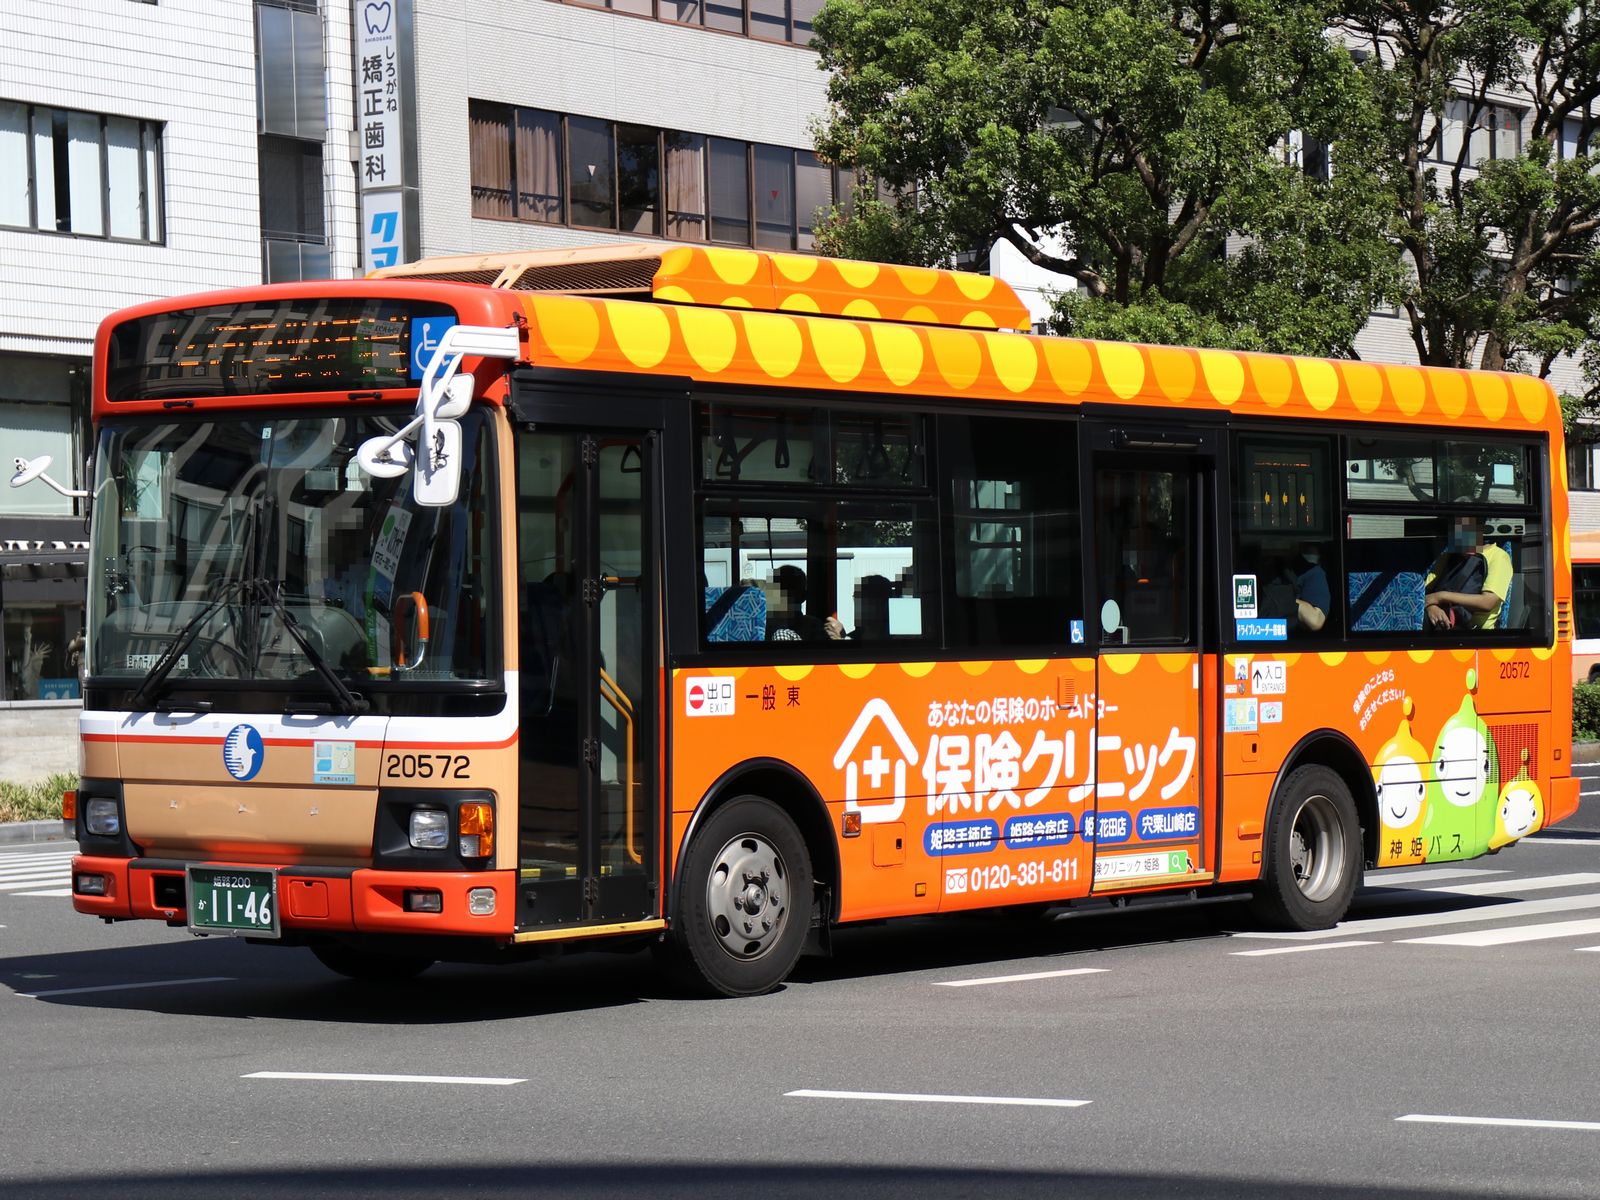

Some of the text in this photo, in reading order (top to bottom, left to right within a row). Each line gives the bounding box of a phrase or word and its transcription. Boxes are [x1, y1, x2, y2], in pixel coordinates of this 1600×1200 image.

[385, 45, 397, 112] しろがね
[362, 54, 386, 182] 矯正歯科
[1238, 585, 1252, 597] NBA
[1264, 665, 1283, 680] 入口
[1500, 661, 1530, 679] 20572
[707, 683, 732, 700] 出口
[745, 684, 801, 711] 一般 東
[1262, 682, 1285, 692] ENTRANCE
[709, 702, 729, 713] EXIT
[387, 754, 470, 779] 20572
[922, 726, 1197, 816] 保険クリニック
[1084, 815, 1127, 838] 姫花田店
[1141, 811, 1196, 835] 宍粟山崎店
[1390, 833, 1461, 859] 神姫バス
[970, 857, 1078, 892] 0120-381-811
[1144, 857, 1160, 872] 姫路
[198, 889, 271, 925] か 11-46
